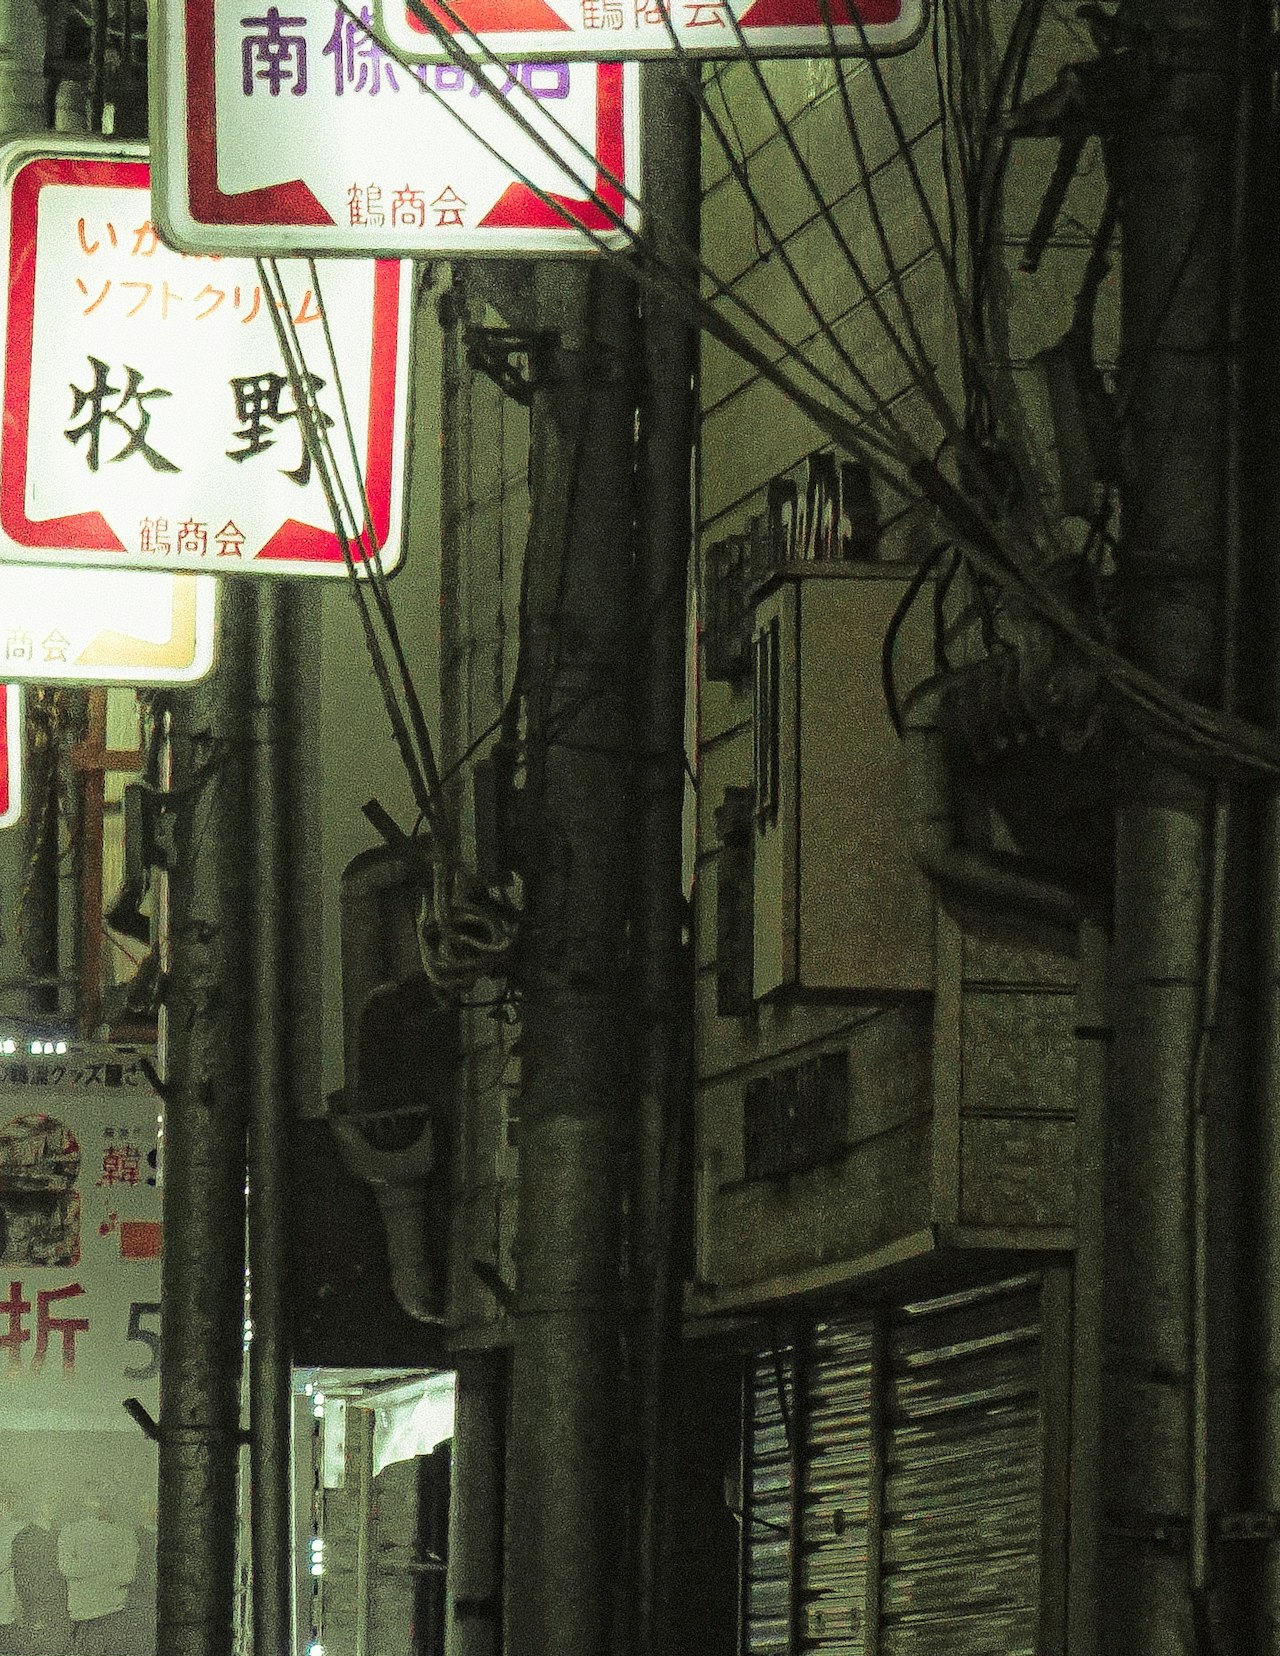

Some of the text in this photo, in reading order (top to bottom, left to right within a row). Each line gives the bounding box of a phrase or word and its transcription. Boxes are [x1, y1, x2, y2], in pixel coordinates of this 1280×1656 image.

[347, 181, 468, 228] 鶴商会
[64, 354, 336, 487] 牧野
[137, 516, 248, 559] 鶴商会
